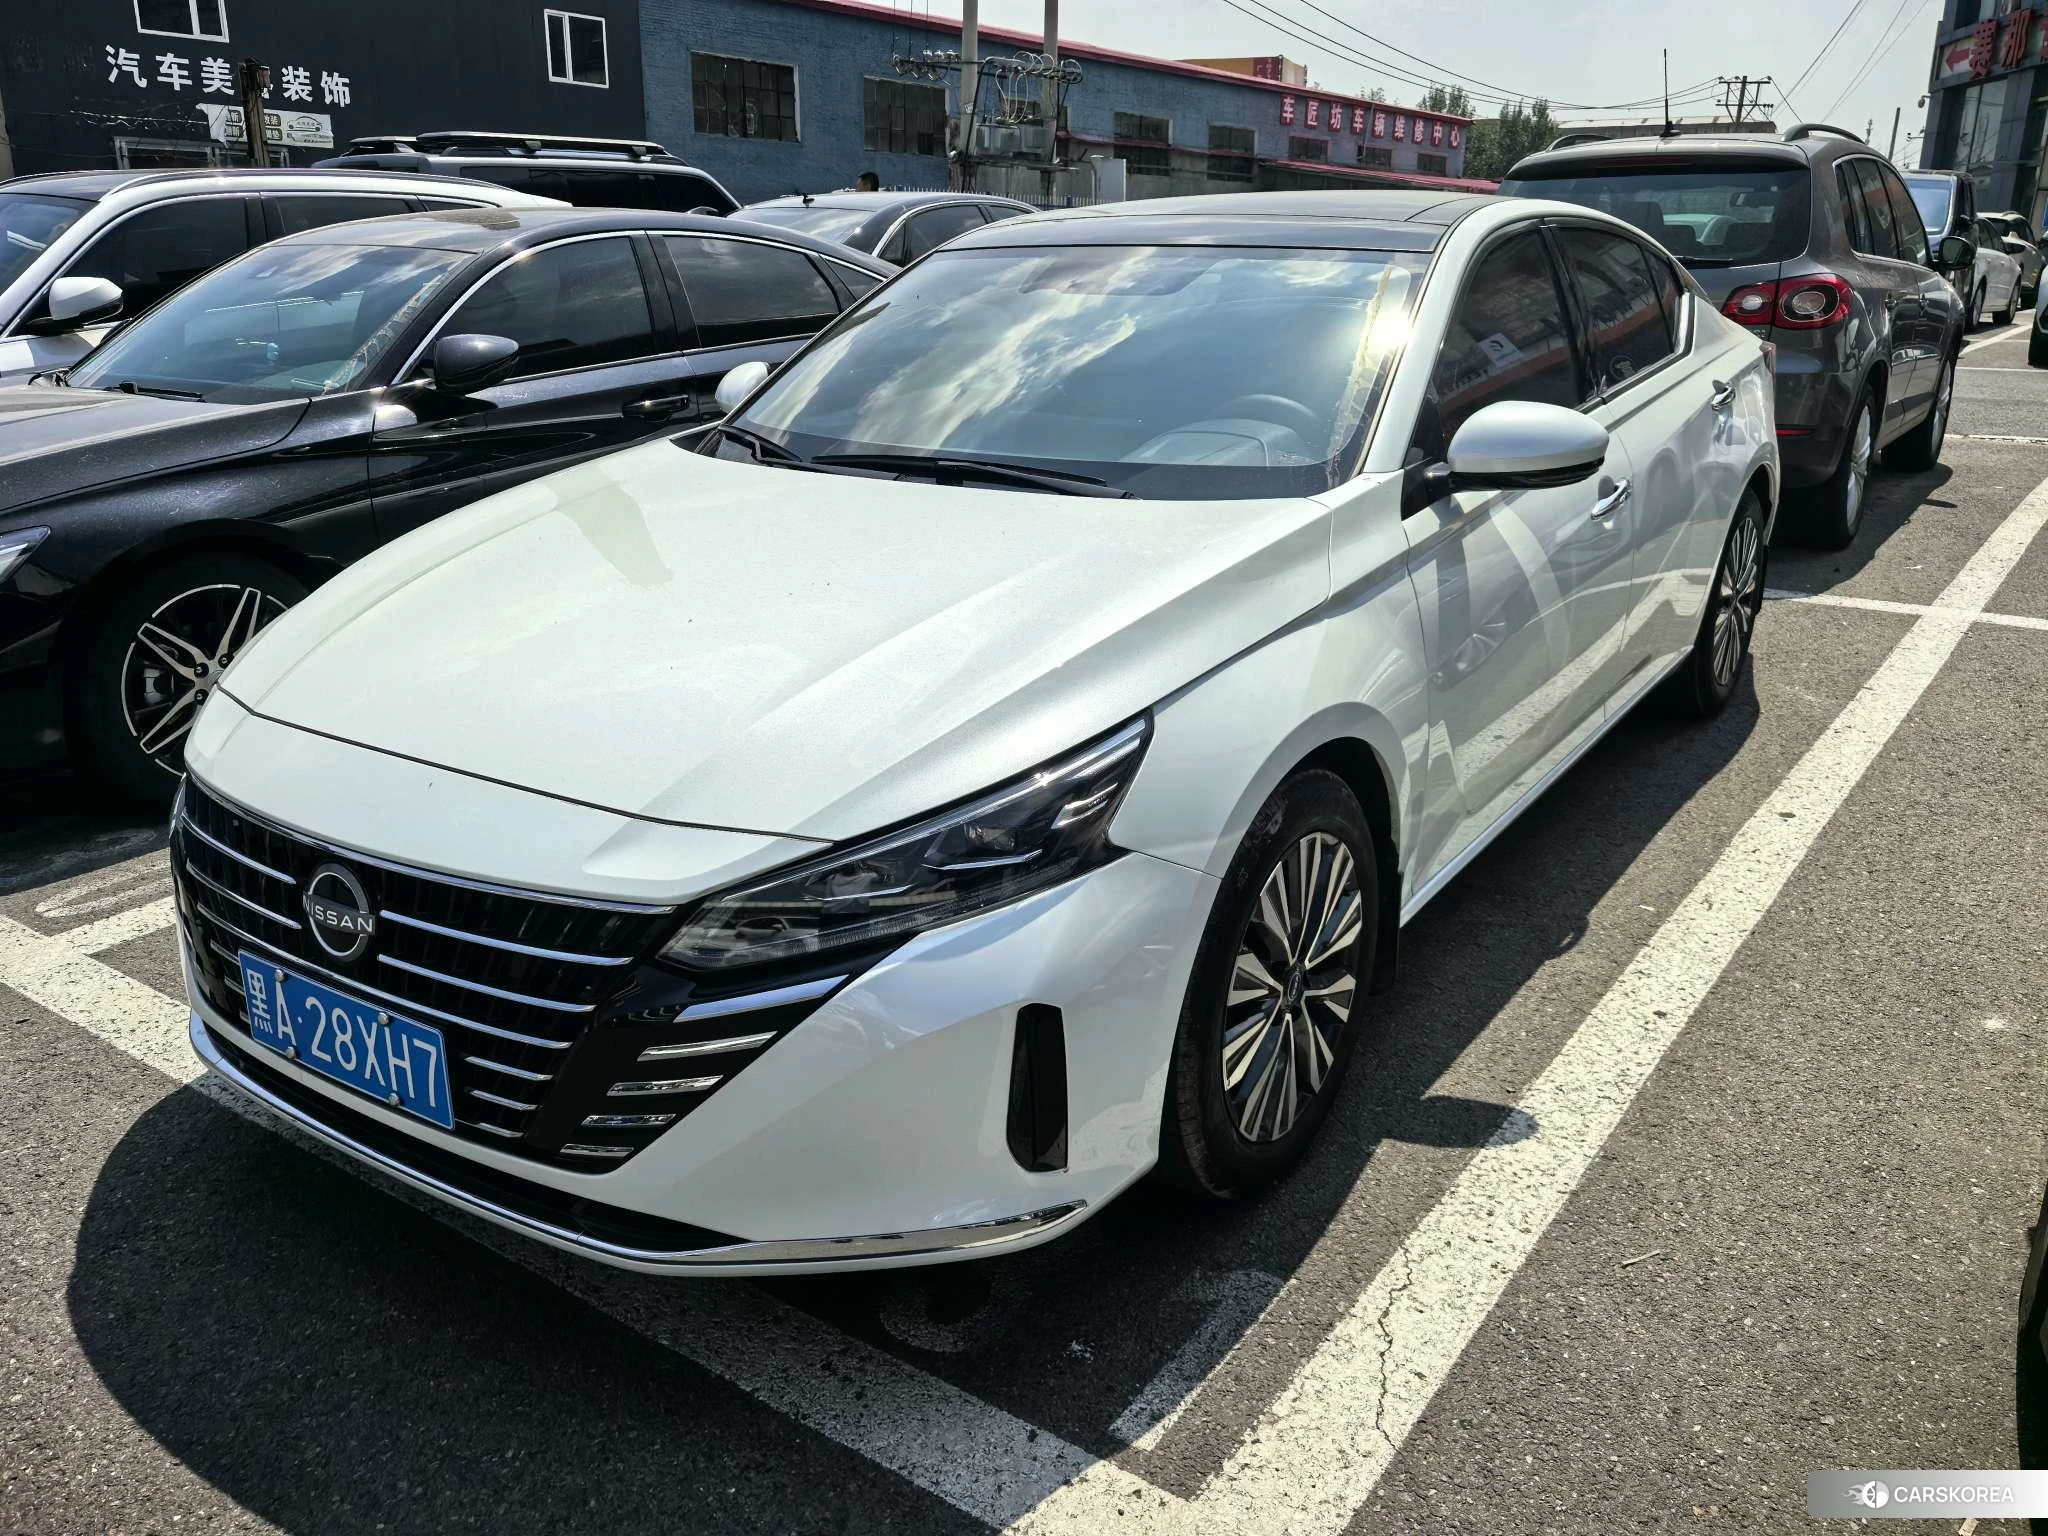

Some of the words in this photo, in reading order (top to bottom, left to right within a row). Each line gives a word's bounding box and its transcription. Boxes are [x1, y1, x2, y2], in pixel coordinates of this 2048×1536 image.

[105, 44, 351, 108] 汽车美装饰
[302, 894, 374, 933] NISSAN
